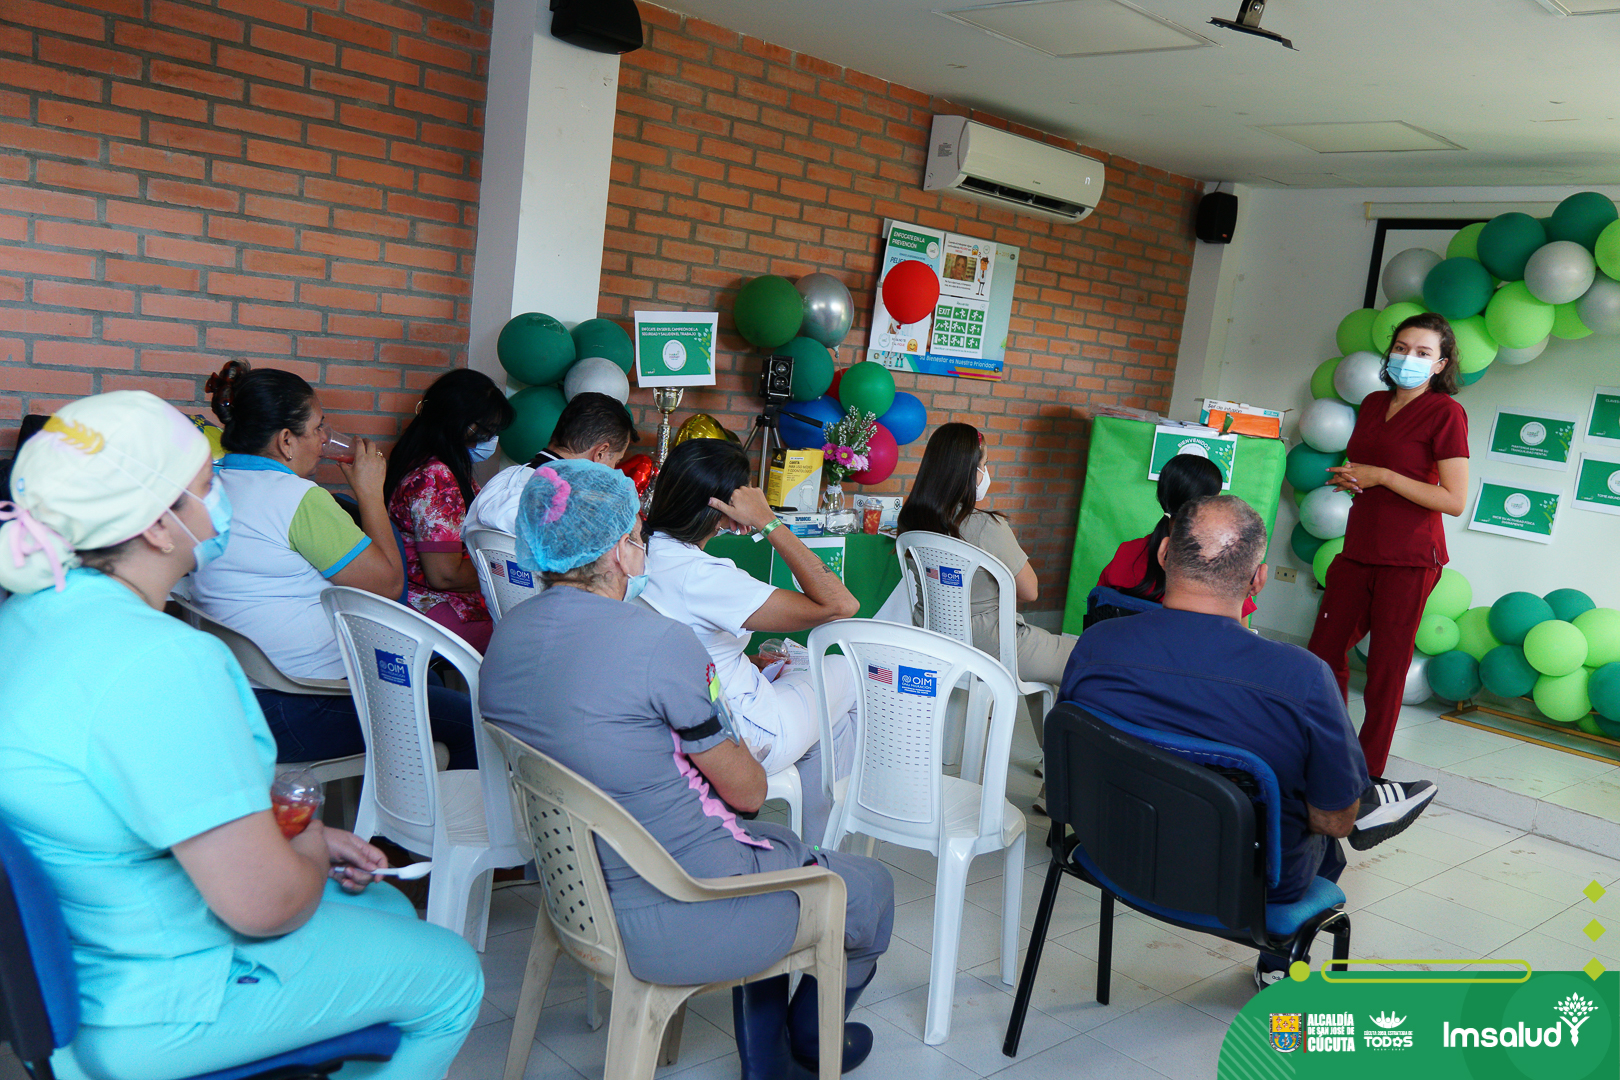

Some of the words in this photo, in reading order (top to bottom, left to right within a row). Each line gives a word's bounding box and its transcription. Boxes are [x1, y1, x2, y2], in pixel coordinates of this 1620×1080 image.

[892, 238, 918, 249] PREVENCIÓN
[938, 307, 951, 316] EXIT
[926, 355, 949, 363] Bienestar
[1177, 438, 1211, 451] BIENVENIDOS
[387, 662, 405, 675] OIM
[912, 676, 932, 687] OIM
